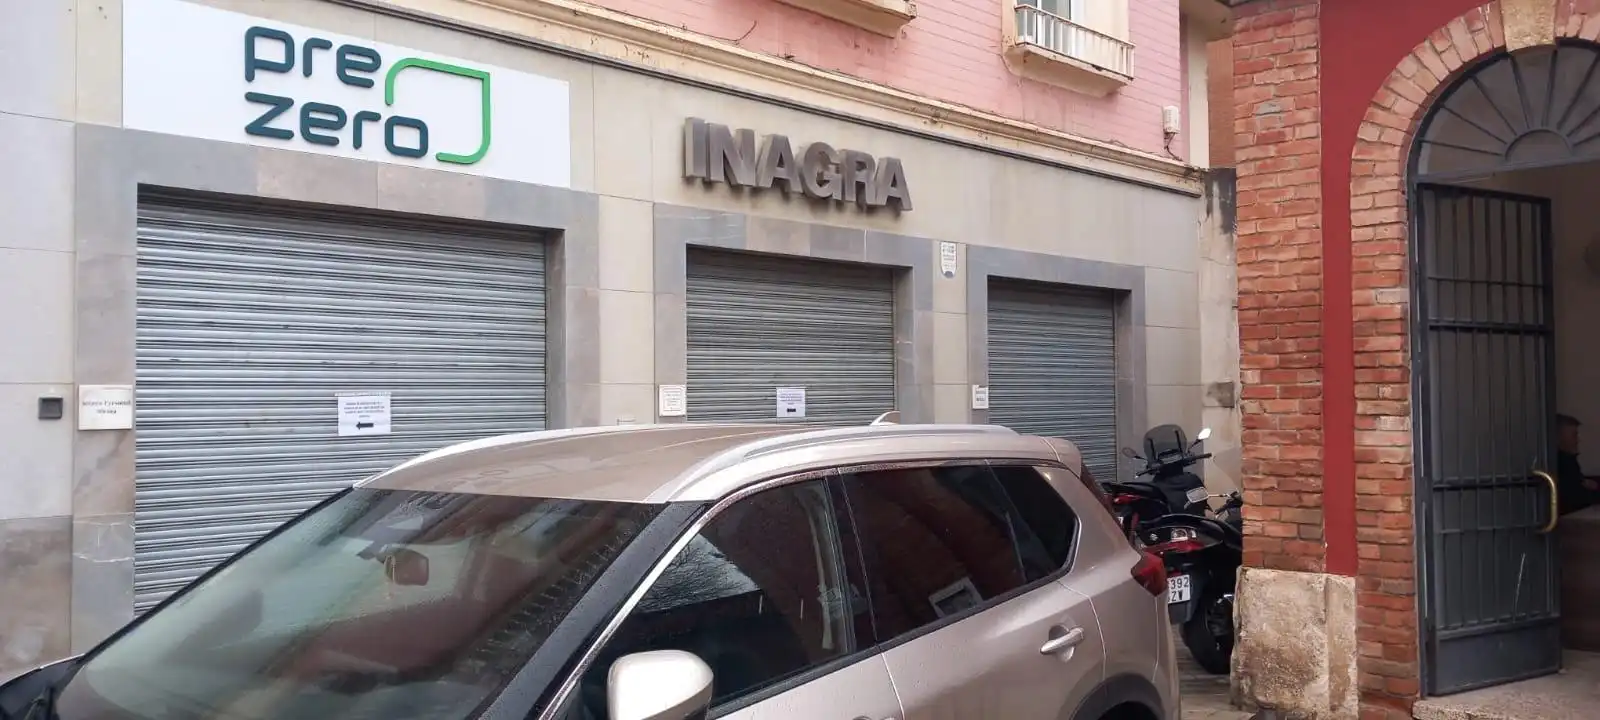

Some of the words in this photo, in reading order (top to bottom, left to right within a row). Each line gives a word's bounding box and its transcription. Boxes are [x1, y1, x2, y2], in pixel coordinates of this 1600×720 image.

[245, 26, 382, 88] pre
[245, 91, 429, 158] zero
[684, 117, 913, 212] INAGRA
[1169, 590, 1184, 602] ZV
[1170, 576, 1189, 590] 392
